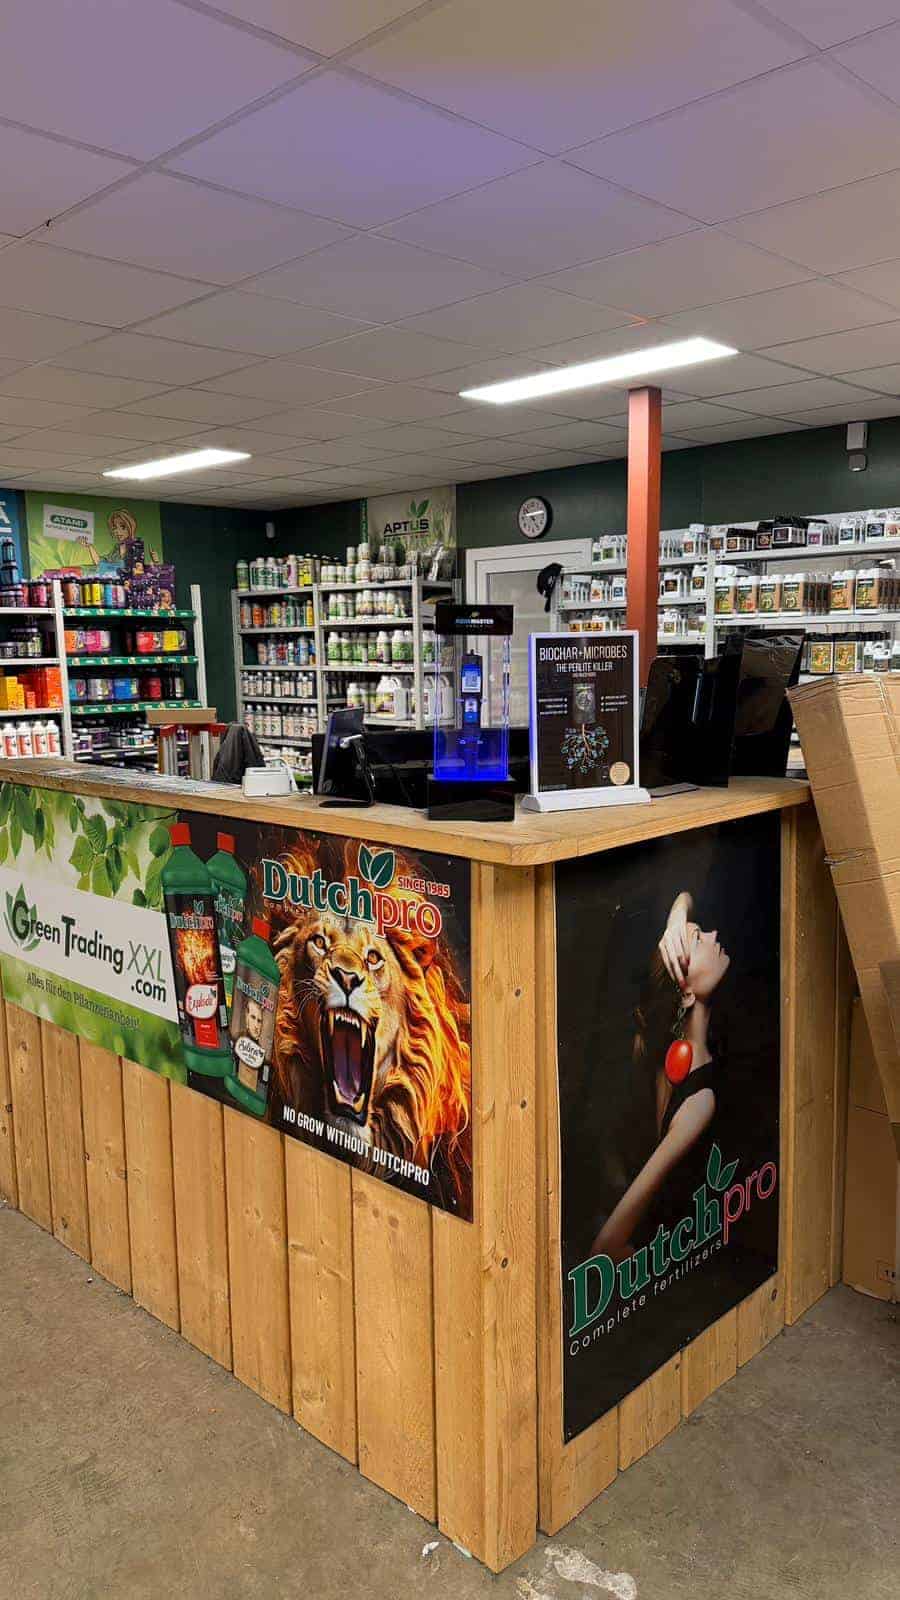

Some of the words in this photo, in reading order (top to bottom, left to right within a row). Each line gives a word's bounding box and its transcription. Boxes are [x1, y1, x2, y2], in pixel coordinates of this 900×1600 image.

[383, 519, 429, 535] APTUS
[556, 663, 567, 673] THE
[592, 661, 614, 671] KILLER
[261, 858, 442, 940] Dutchpro
[397, 876, 425, 893] SINCE
[425, 881, 451, 898] 1985
[26, 972, 45, 990] Alles
[45, 979, 58, 995] für
[57, 984, 73, 1001] den
[130, 978, 167, 1002] .com
[283, 1105, 296, 1124] NO
[297, 1112, 324, 1137] GROW
[326, 1125, 371, 1158] WITHOUT
[372, 1147, 430, 1186] DUTCHPRO
[568, 1161, 777, 1338] Dutchpro
[569, 1295, 646, 1356] Complete
[653, 1239, 722, 1296] fertilizers
